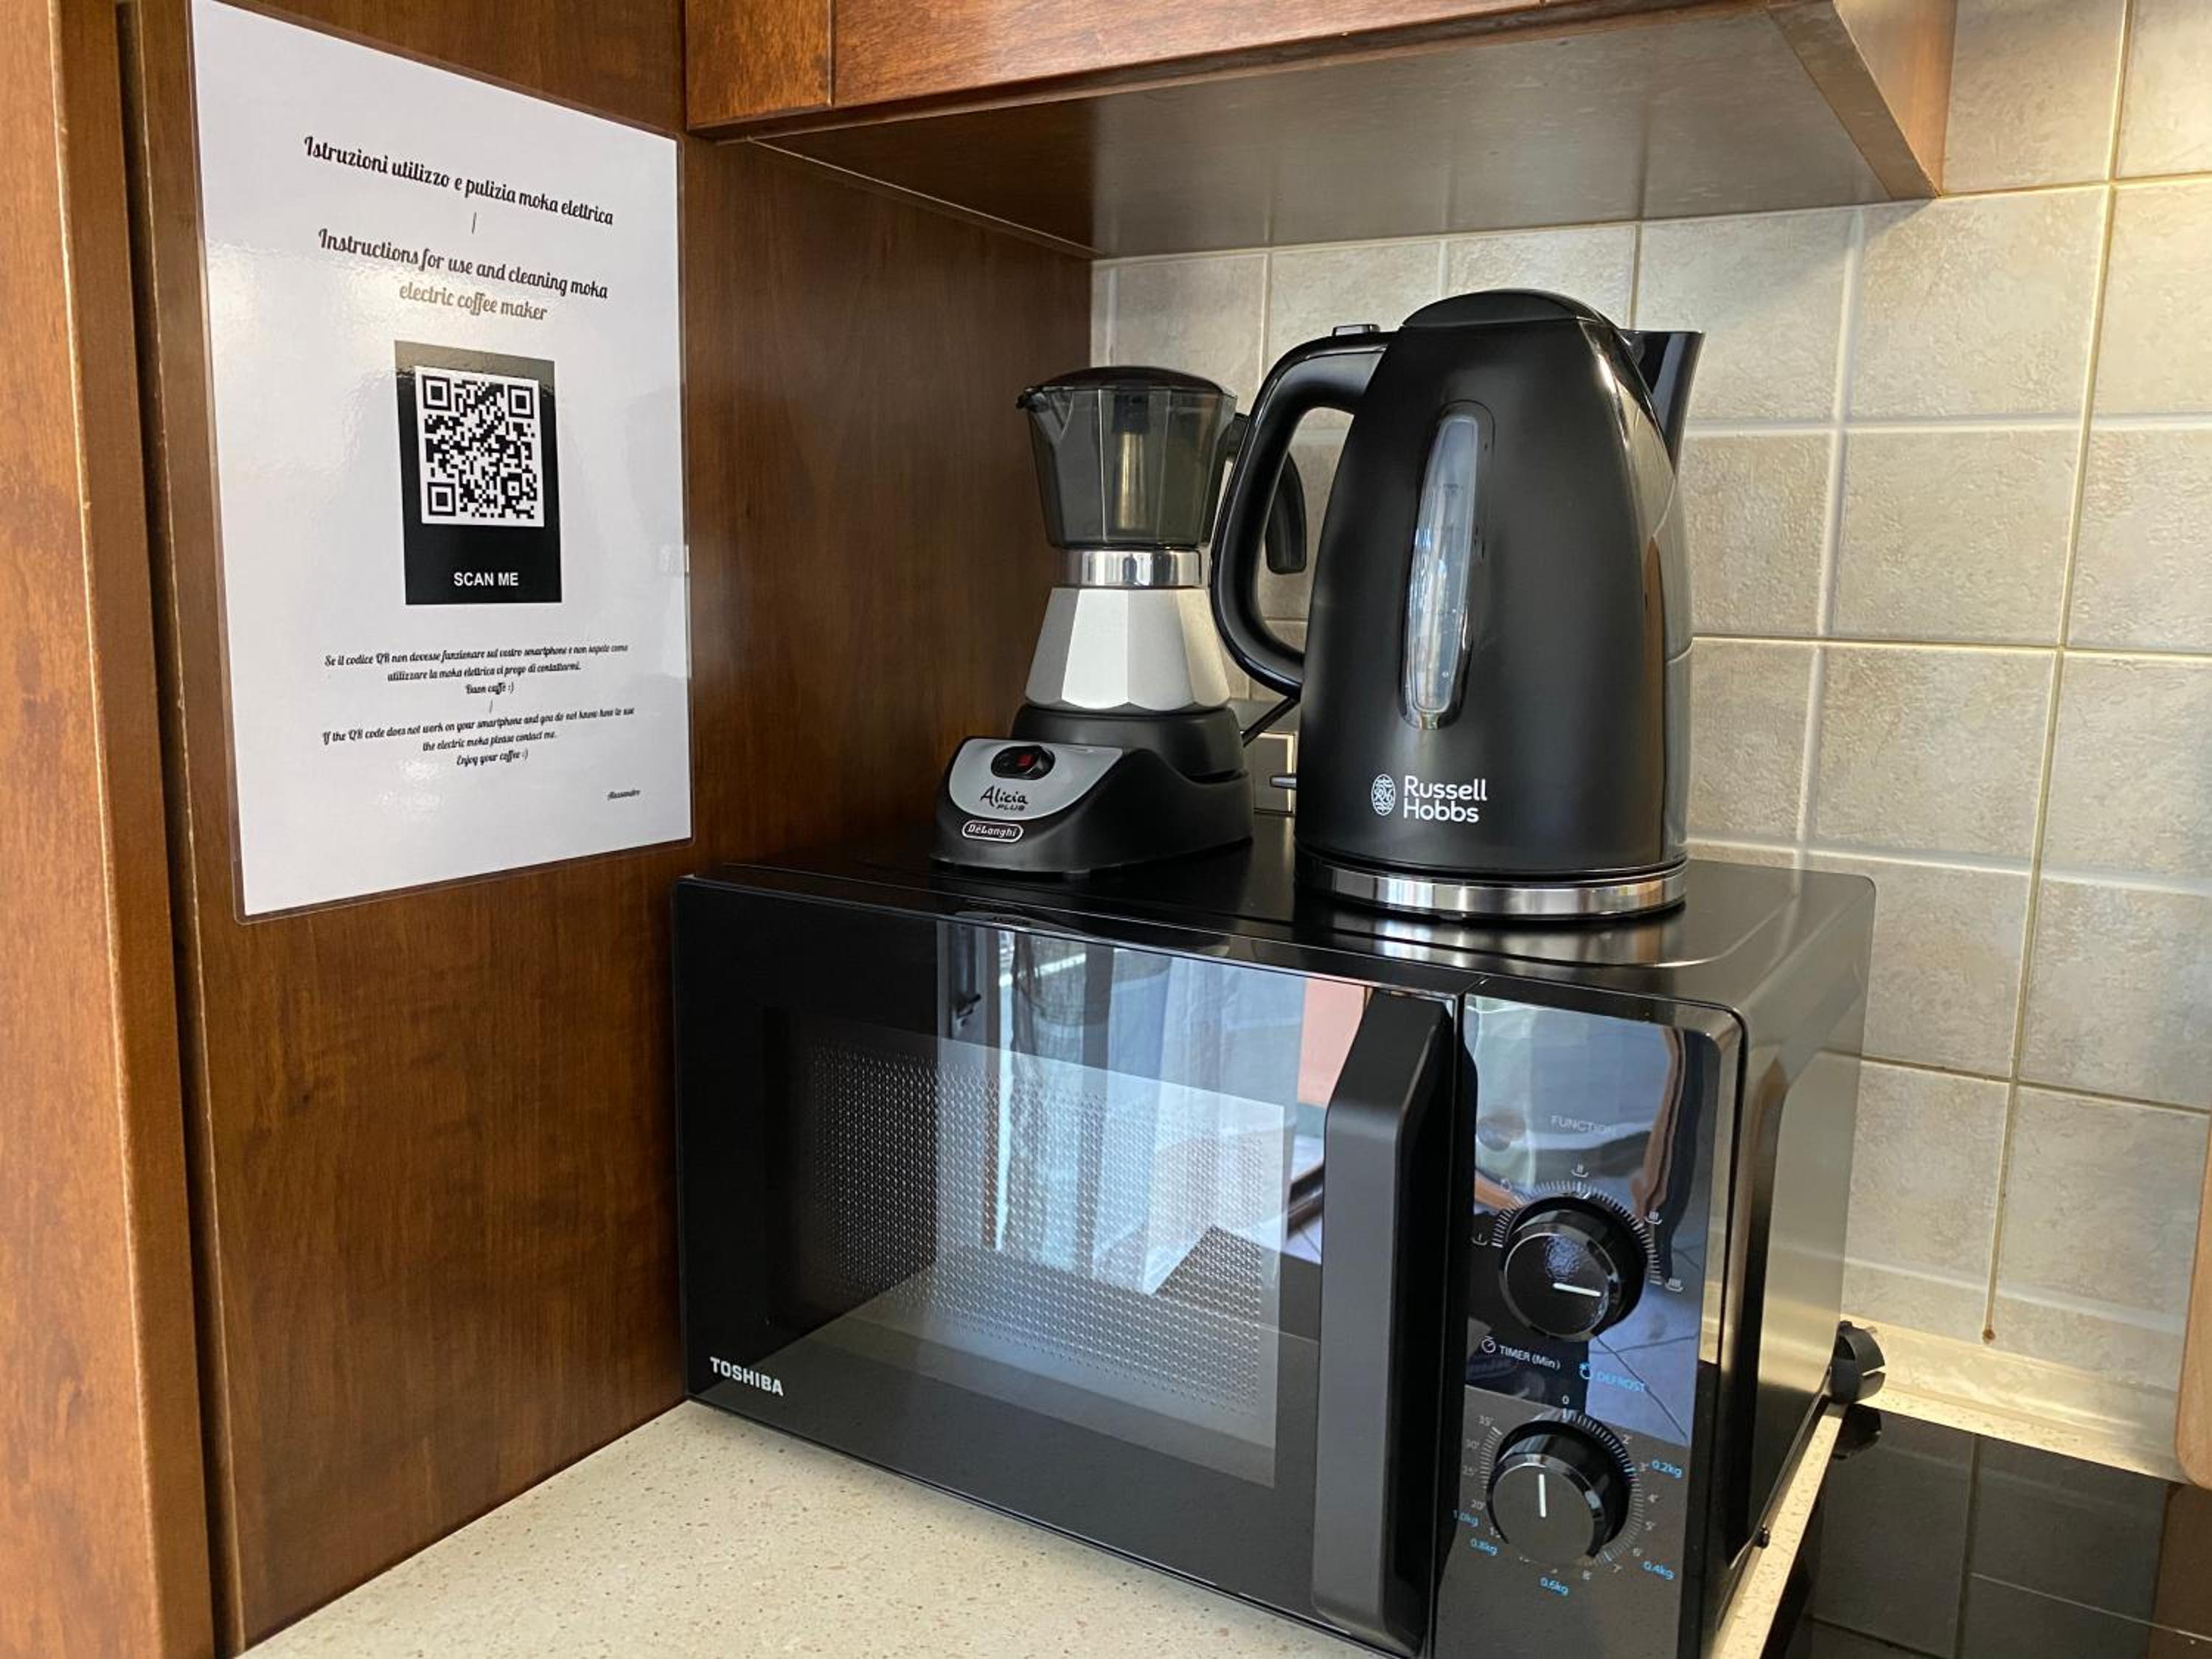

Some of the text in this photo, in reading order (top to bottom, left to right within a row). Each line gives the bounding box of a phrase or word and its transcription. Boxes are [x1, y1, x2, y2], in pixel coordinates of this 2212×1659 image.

[305, 136, 613, 225] Istruzioni utilizzo e pulizia moka elettrica
[319, 228, 608, 299] Instructions for use and cleaning moka
[399, 282, 549, 321] electric coffee maker
[453, 571, 520, 587] SCAN ME
[324, 655, 336, 667] Se
[346, 654, 374, 665] codice
[376, 653, 390, 664] QR
[392, 653, 408, 663] non
[409, 652, 440, 662] dovesse
[441, 650, 485, 663] funzionare
[499, 647, 523, 658] vostro
[524, 646, 568, 658] smartphone
[387, 669, 428, 682] utilizzare
[429, 668, 438, 679] la
[439, 667, 463, 678] moka
[464, 665, 495, 678] elettrica
[333, 730, 347, 742] the
[348, 728, 364, 741] QR
[365, 727, 386, 740] code
[386, 726, 406, 737] does
[407, 725, 421, 736] not
[422, 722, 444, 734] work
[445, 723, 456, 732] on
[456, 720, 476, 733] your
[476, 717, 522, 728] smartphone
[523, 714, 539, 724] and
[540, 714, 554, 726] you
[554, 712, 564, 722] do
[566, 712, 578, 720] not
[579, 709, 598, 720] know
[422, 740, 436, 751] the
[437, 739, 465, 750] electric
[467, 734, 489, 745] moka
[490, 734, 515, 747] please
[515, 731, 542, 742] contact
[456, 755, 479, 768] Enjoy
[479, 754, 498, 765] your
[499, 750, 521, 763] coffee
[980, 785, 1029, 807] Alicia
[1404, 775, 1488, 801] Russell
[1403, 797, 1480, 824] Hobbs
[1498, 1344, 1531, 1362] TIMER
[710, 1357, 784, 1397] TOSHIBA
[1596, 1371, 1646, 1393] DEFROST
[1561, 1394, 1571, 1405] 0
[1651, 1460, 1683, 1479] 0.2kg
